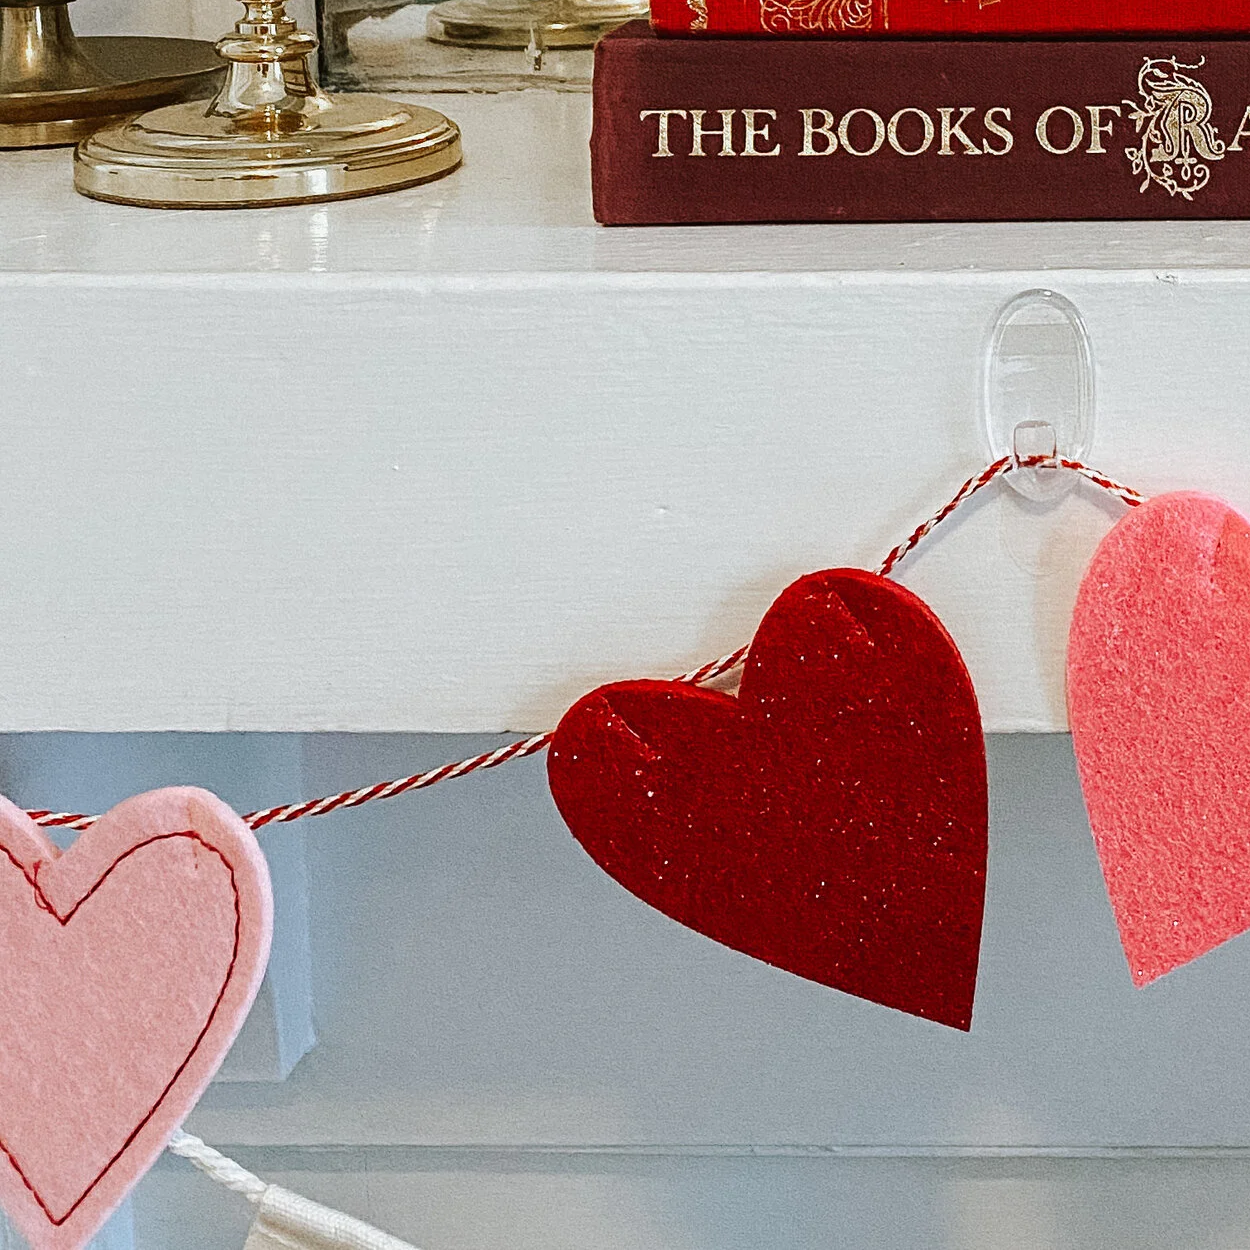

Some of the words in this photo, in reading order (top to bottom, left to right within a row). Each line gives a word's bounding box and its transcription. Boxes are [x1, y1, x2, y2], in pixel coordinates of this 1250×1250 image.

[639, 108, 781, 158] THE
[797, 107, 1014, 157] BOOKS
[1035, 104, 1121, 154] OF
